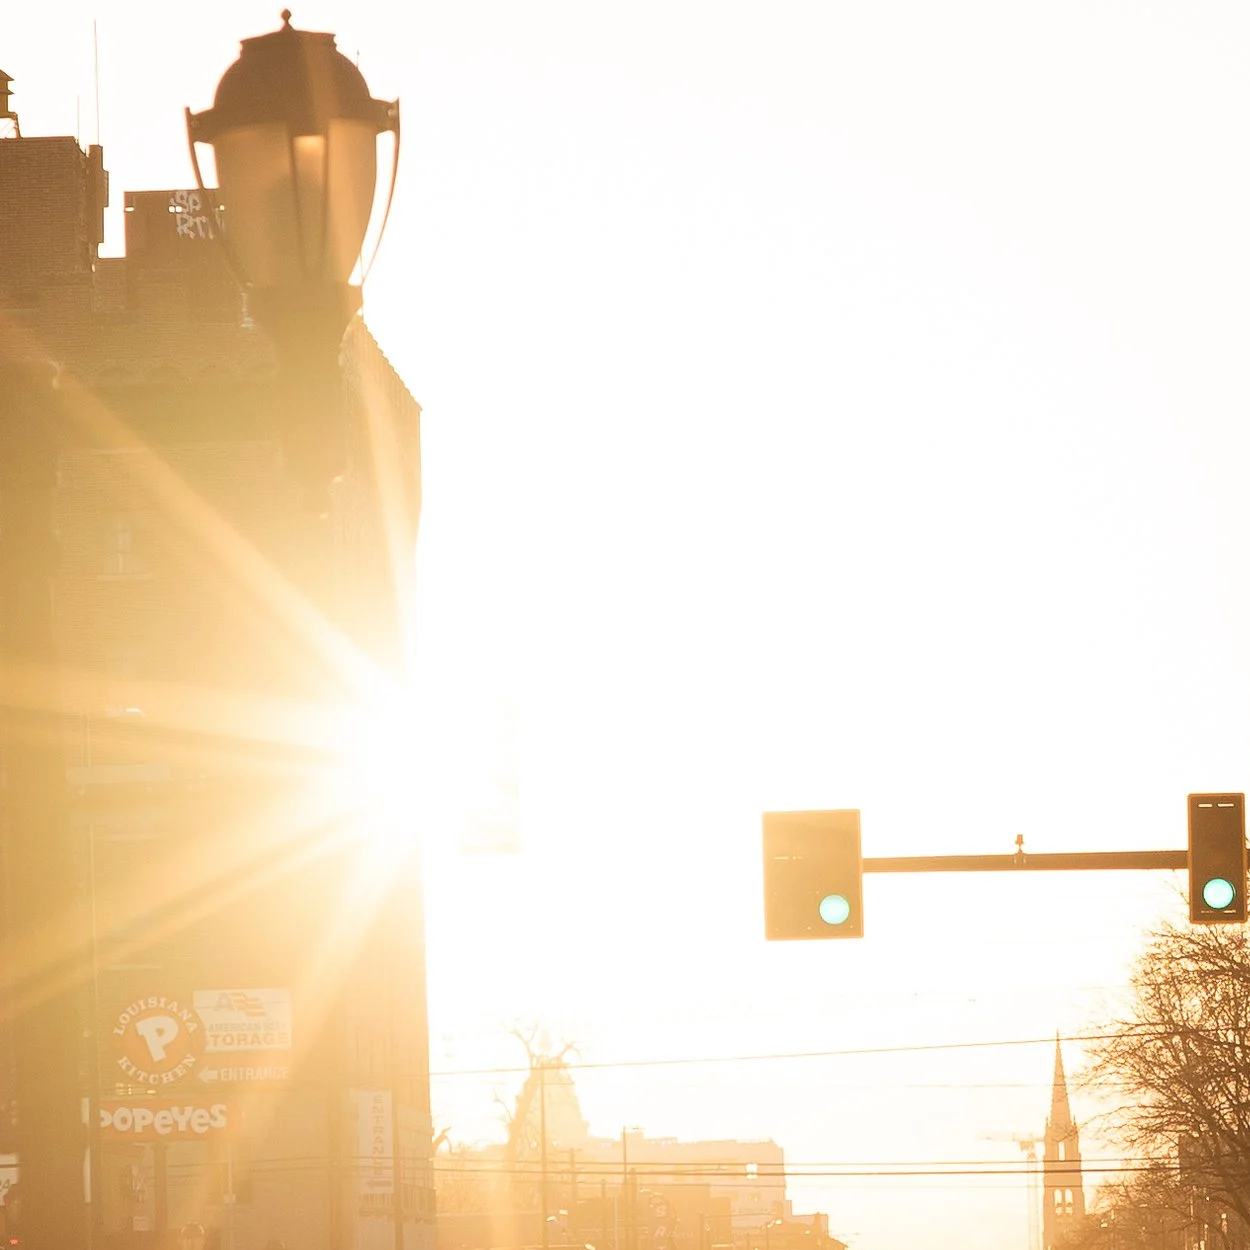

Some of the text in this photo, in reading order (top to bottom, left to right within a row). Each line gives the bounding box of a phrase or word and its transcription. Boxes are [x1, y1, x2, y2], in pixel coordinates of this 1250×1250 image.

[113, 996, 197, 1037] LOUISIANA
[208, 1021, 262, 1033] AMERICAN
[136, 1016, 179, 1062] P
[209, 1032, 289, 1047] TORAGE
[117, 1053, 196, 1085] KITCHEN
[220, 1066, 289, 1081] ENTRANCE
[372, 1095, 385, 1176] ENTRANCE
